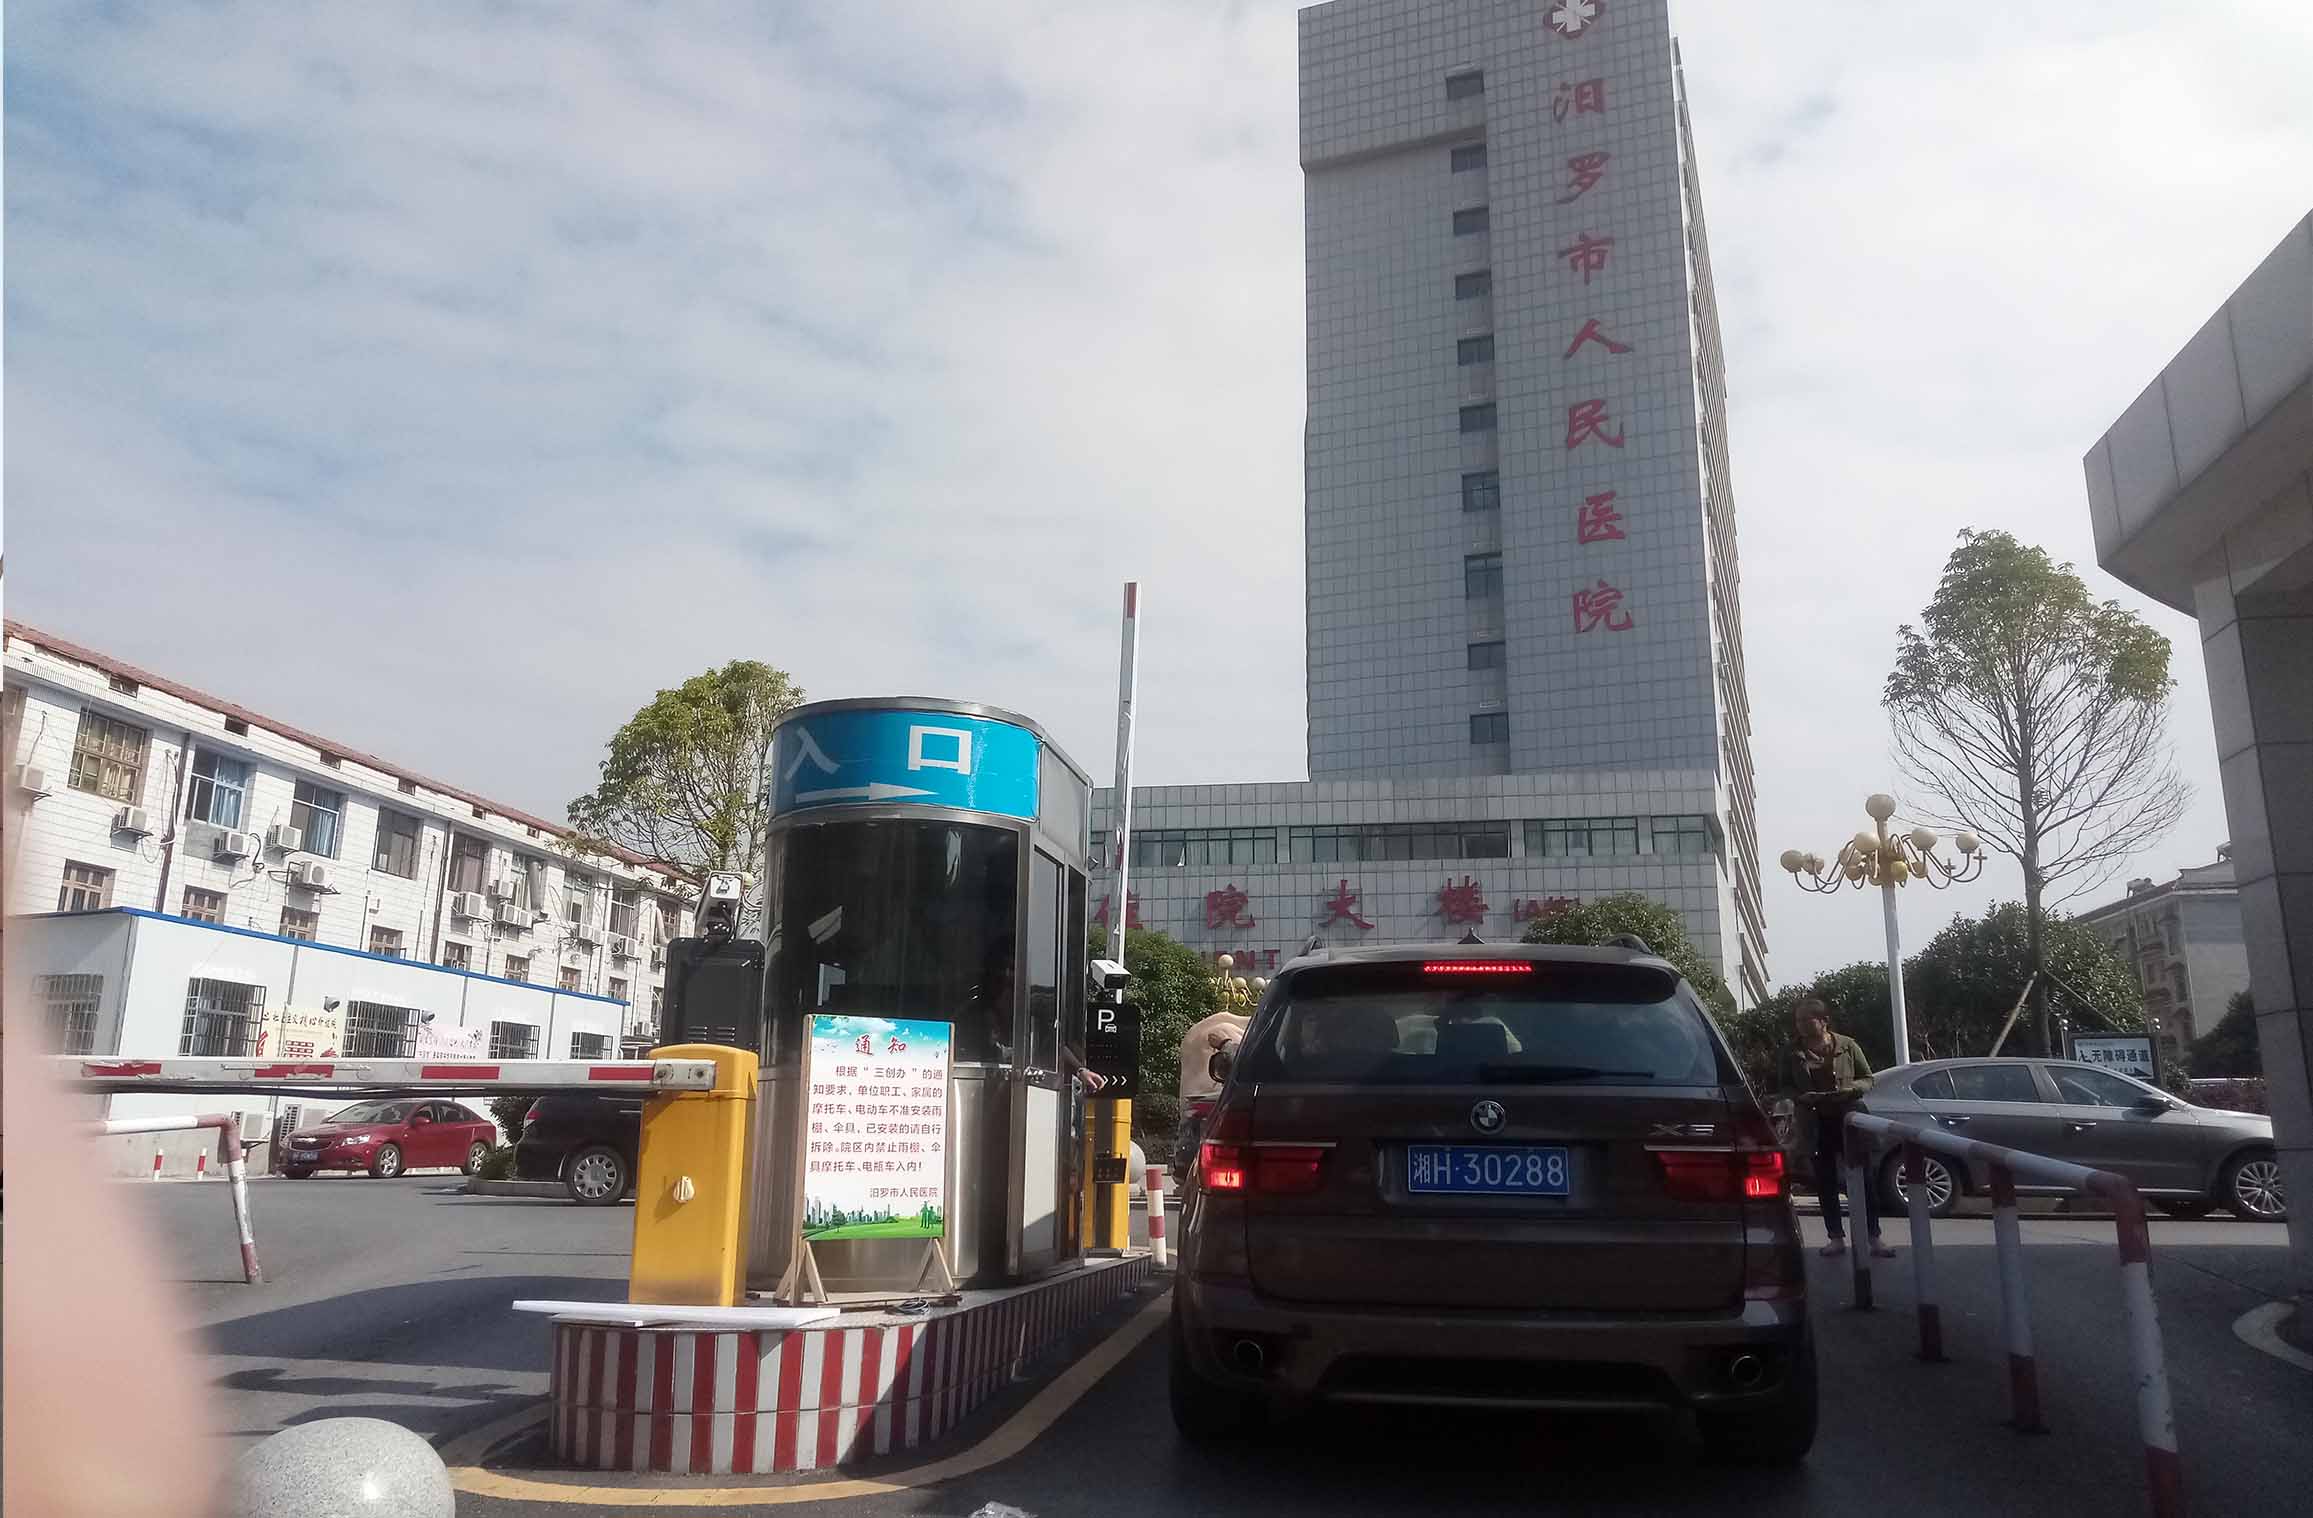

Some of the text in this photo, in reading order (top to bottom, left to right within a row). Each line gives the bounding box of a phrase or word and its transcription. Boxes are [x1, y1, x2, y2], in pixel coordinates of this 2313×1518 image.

[1553, 79, 1633, 633] 汨罗市人民医院
[784, 725, 972, 782] 入口
[855, 1033, 907, 1056] 通知
[2091, 1049, 2149, 1063] 无障碍通道
[869, 1186, 939, 1199] 汨罗市人民医院
